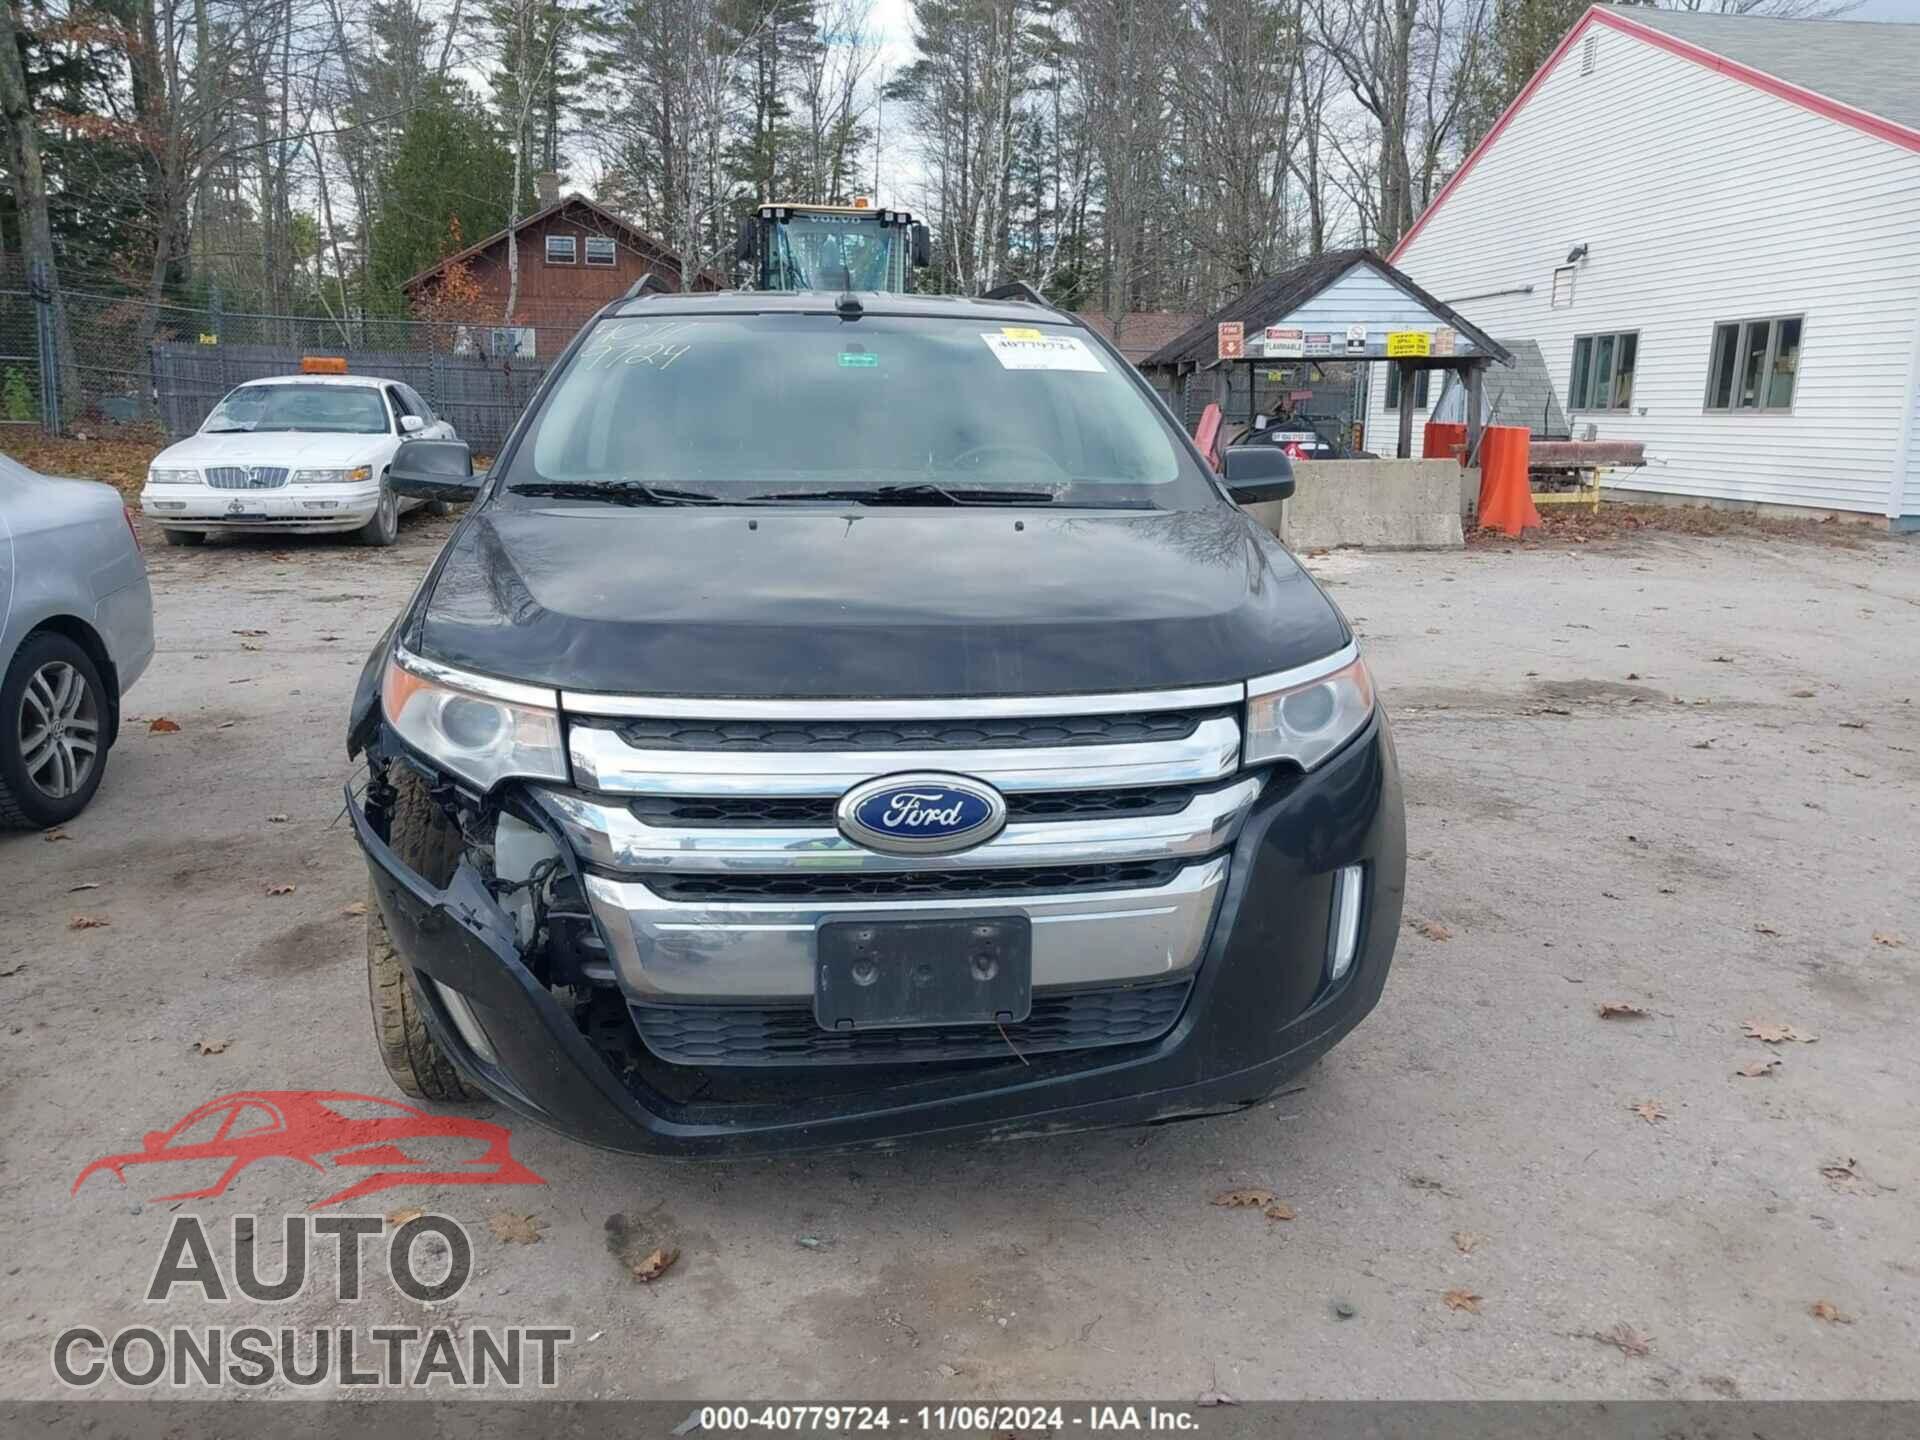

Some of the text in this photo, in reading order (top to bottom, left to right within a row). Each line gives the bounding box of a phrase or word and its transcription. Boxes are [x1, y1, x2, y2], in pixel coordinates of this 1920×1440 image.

[810, 214, 861, 225] VOLVO
[1265, 342, 1301, 351] FLAMMABLE
[883, 793, 963, 828] Ford
